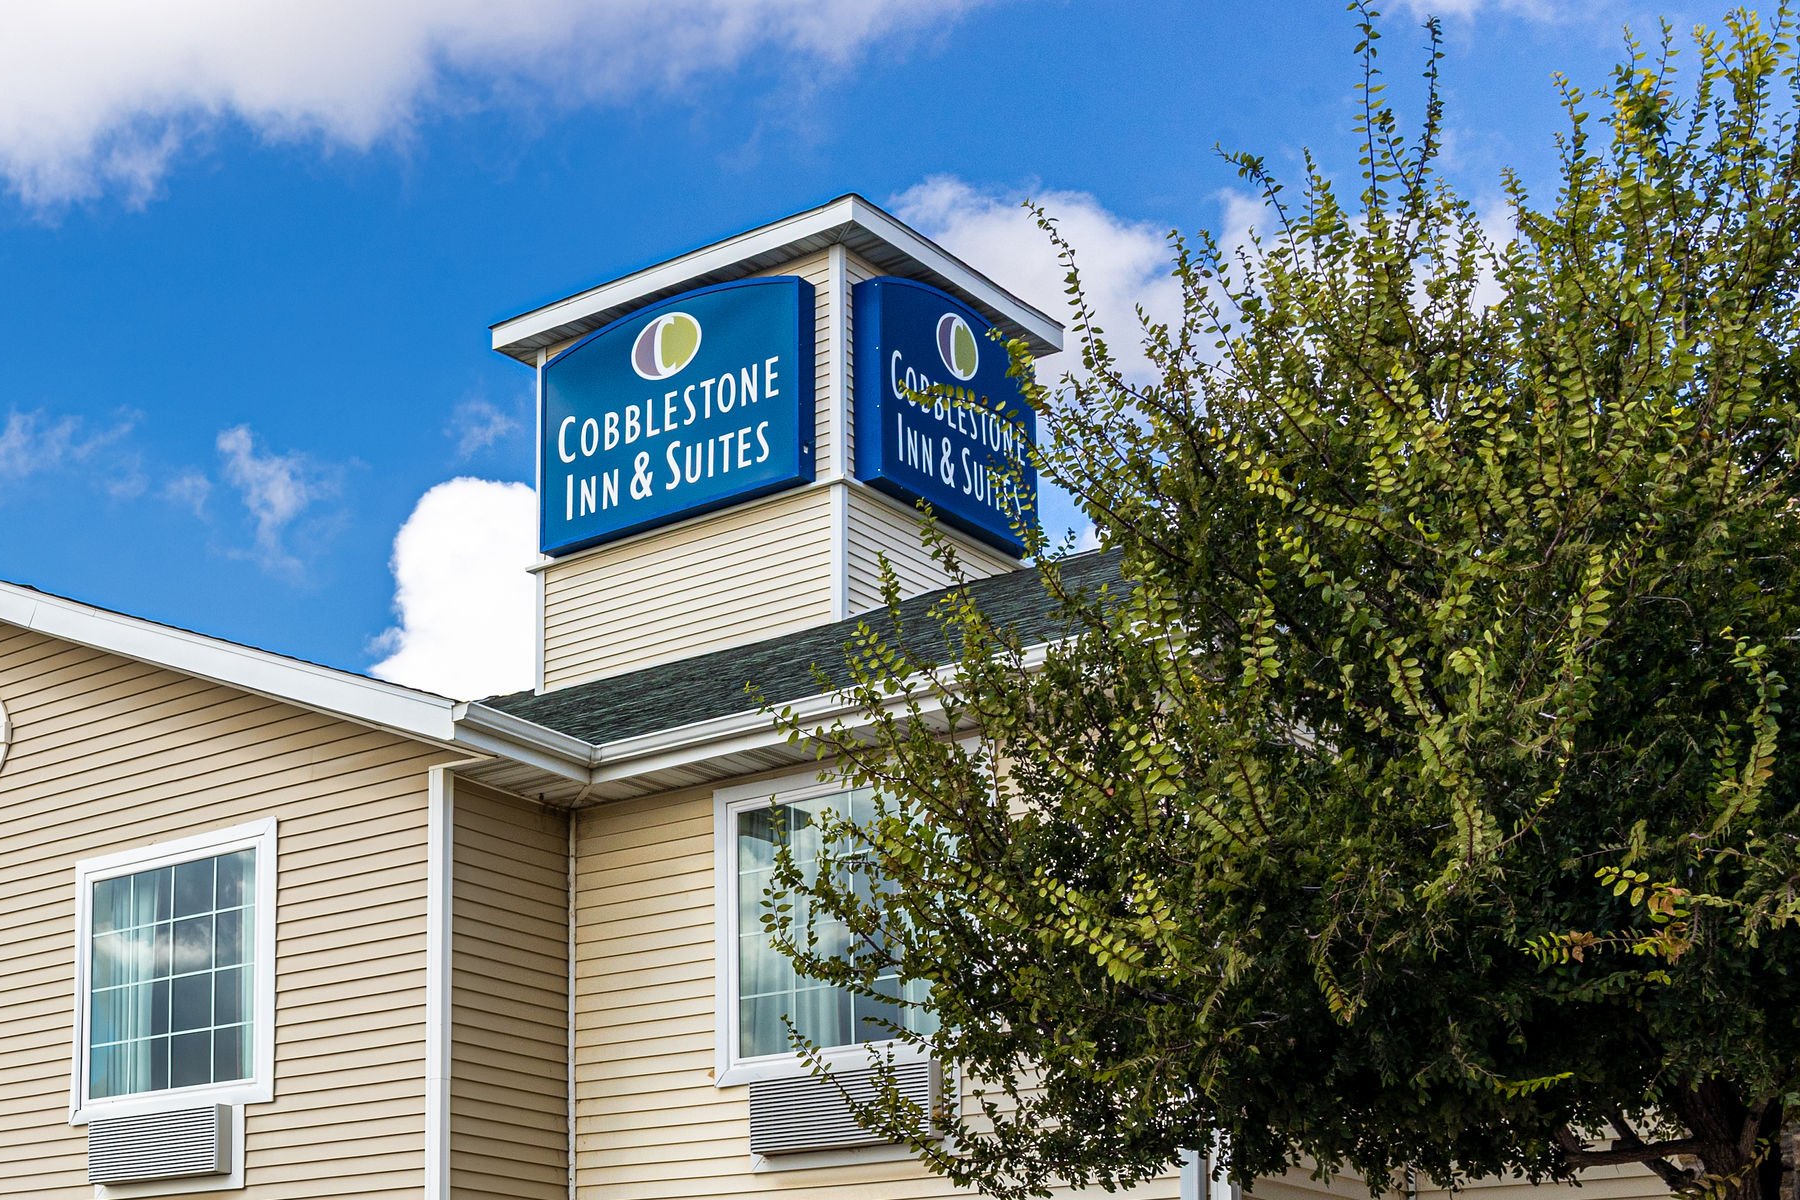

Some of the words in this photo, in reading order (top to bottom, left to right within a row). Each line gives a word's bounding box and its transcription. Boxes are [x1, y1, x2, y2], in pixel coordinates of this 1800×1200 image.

[558, 355, 780, 464] COBBLESTONE
[897, 413, 934, 477] INN
[940, 437, 956, 489] &
[566, 468, 619, 521] INN
[630, 451, 653, 501] &
[666, 421, 770, 491] SUITES
